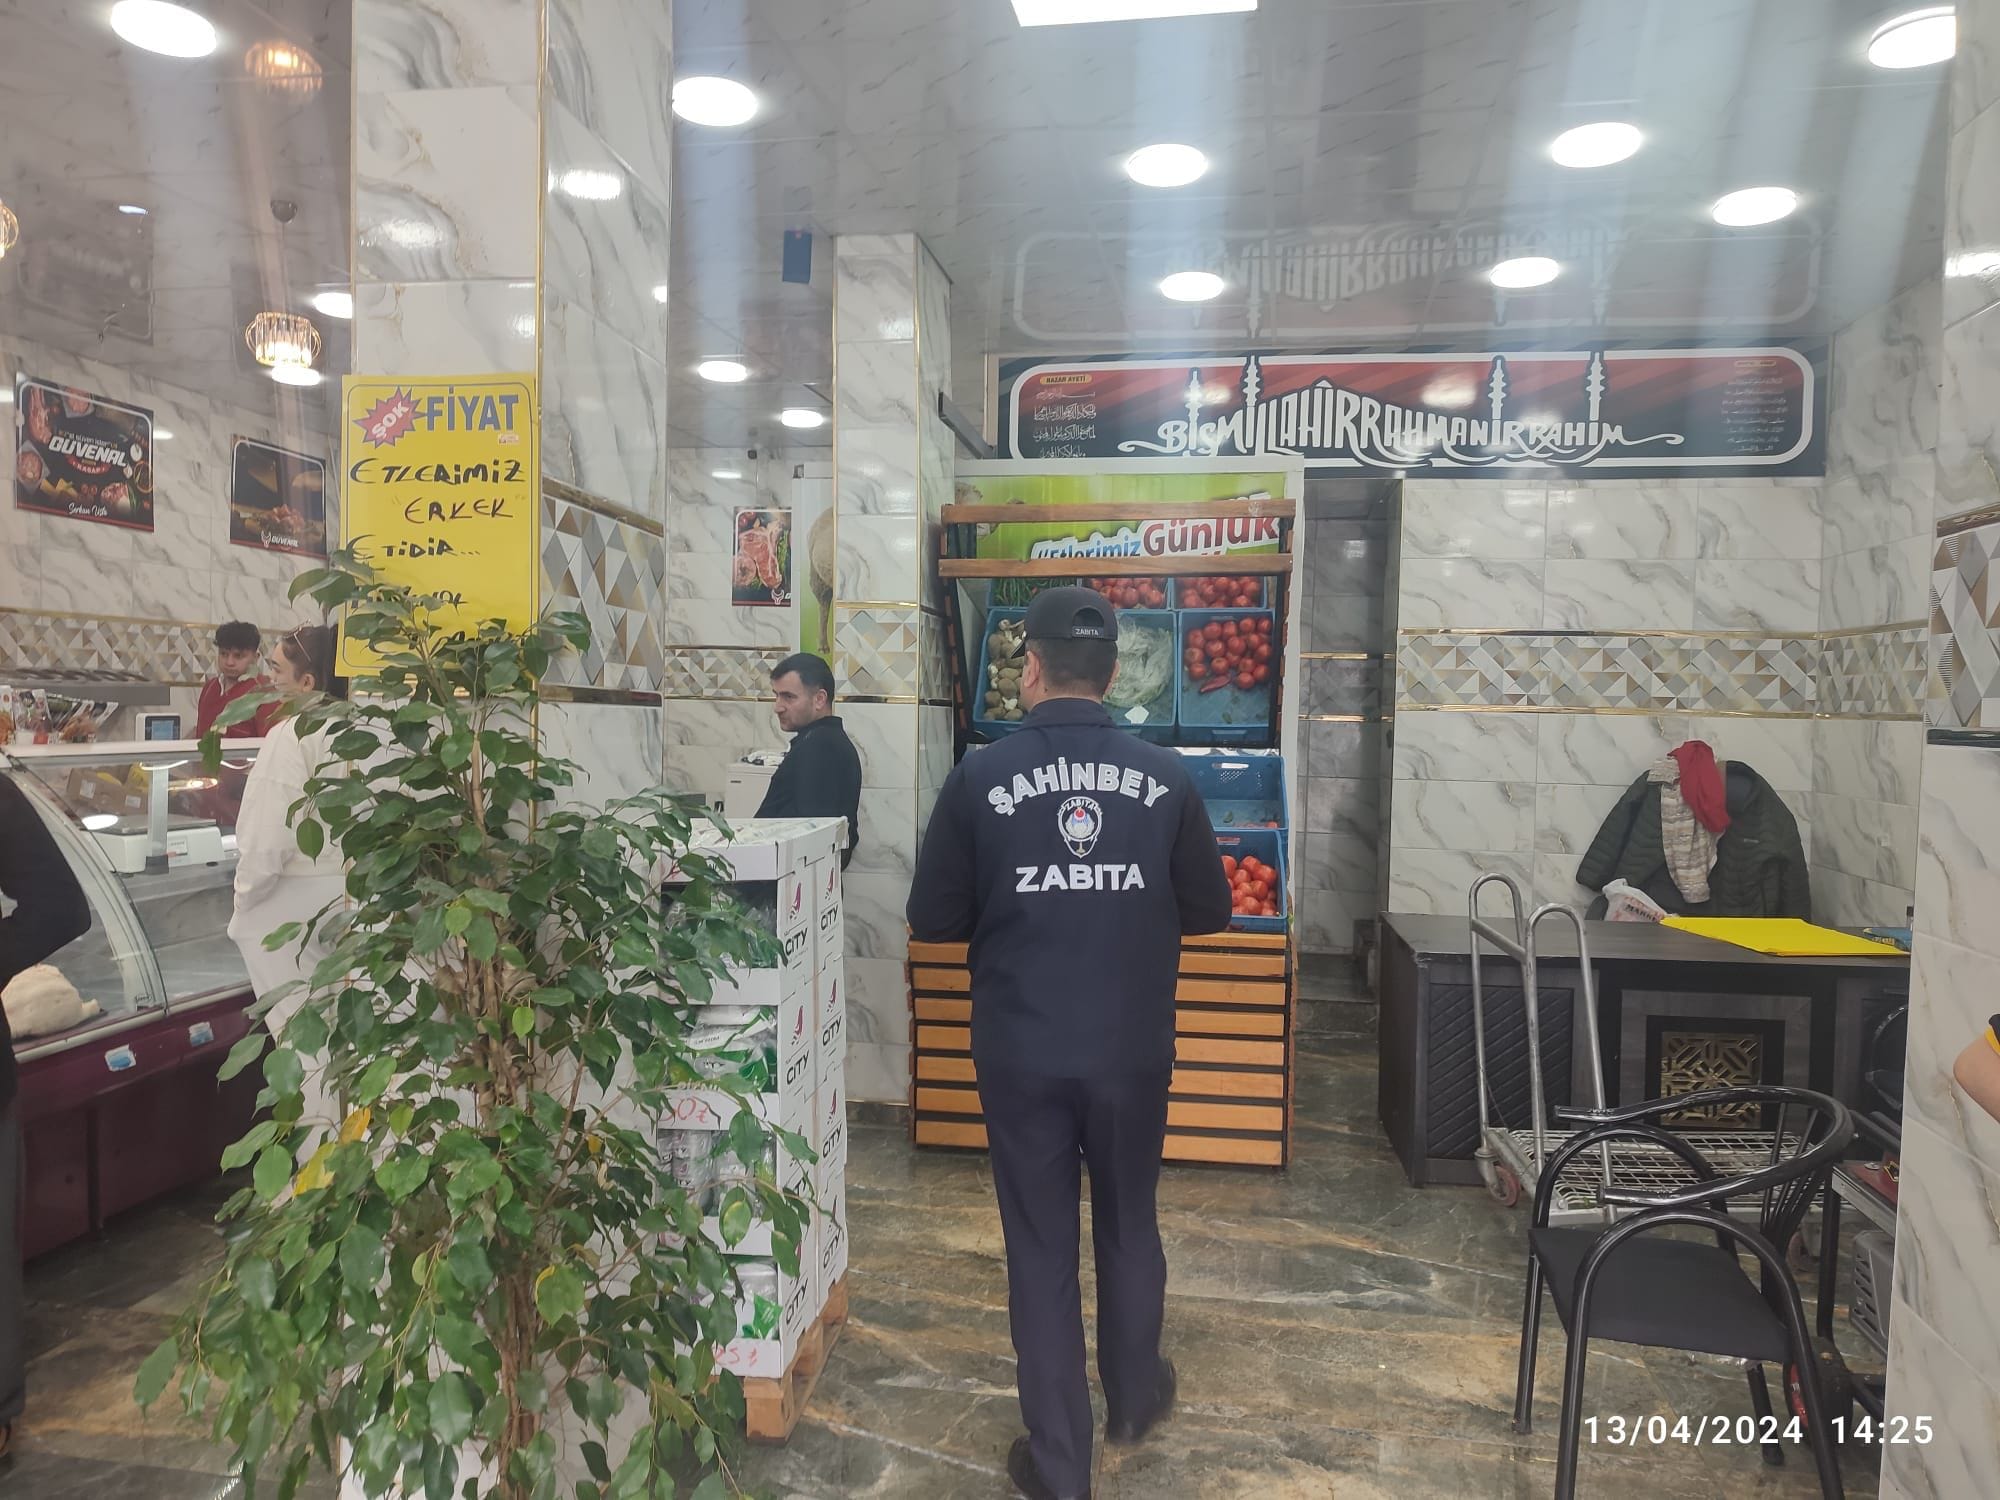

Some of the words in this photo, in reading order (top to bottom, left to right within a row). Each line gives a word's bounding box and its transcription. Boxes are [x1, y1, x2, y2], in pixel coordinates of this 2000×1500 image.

[371, 401, 409, 440] ŞOK
[426, 385, 519, 431] FİYAT
[1074, 628, 1099, 636] ZABITA
[988, 757, 1169, 816] ŞAHİNBEY
[1065, 799, 1096, 811] ZABITA
[1015, 864, 1145, 893] ZABITA
